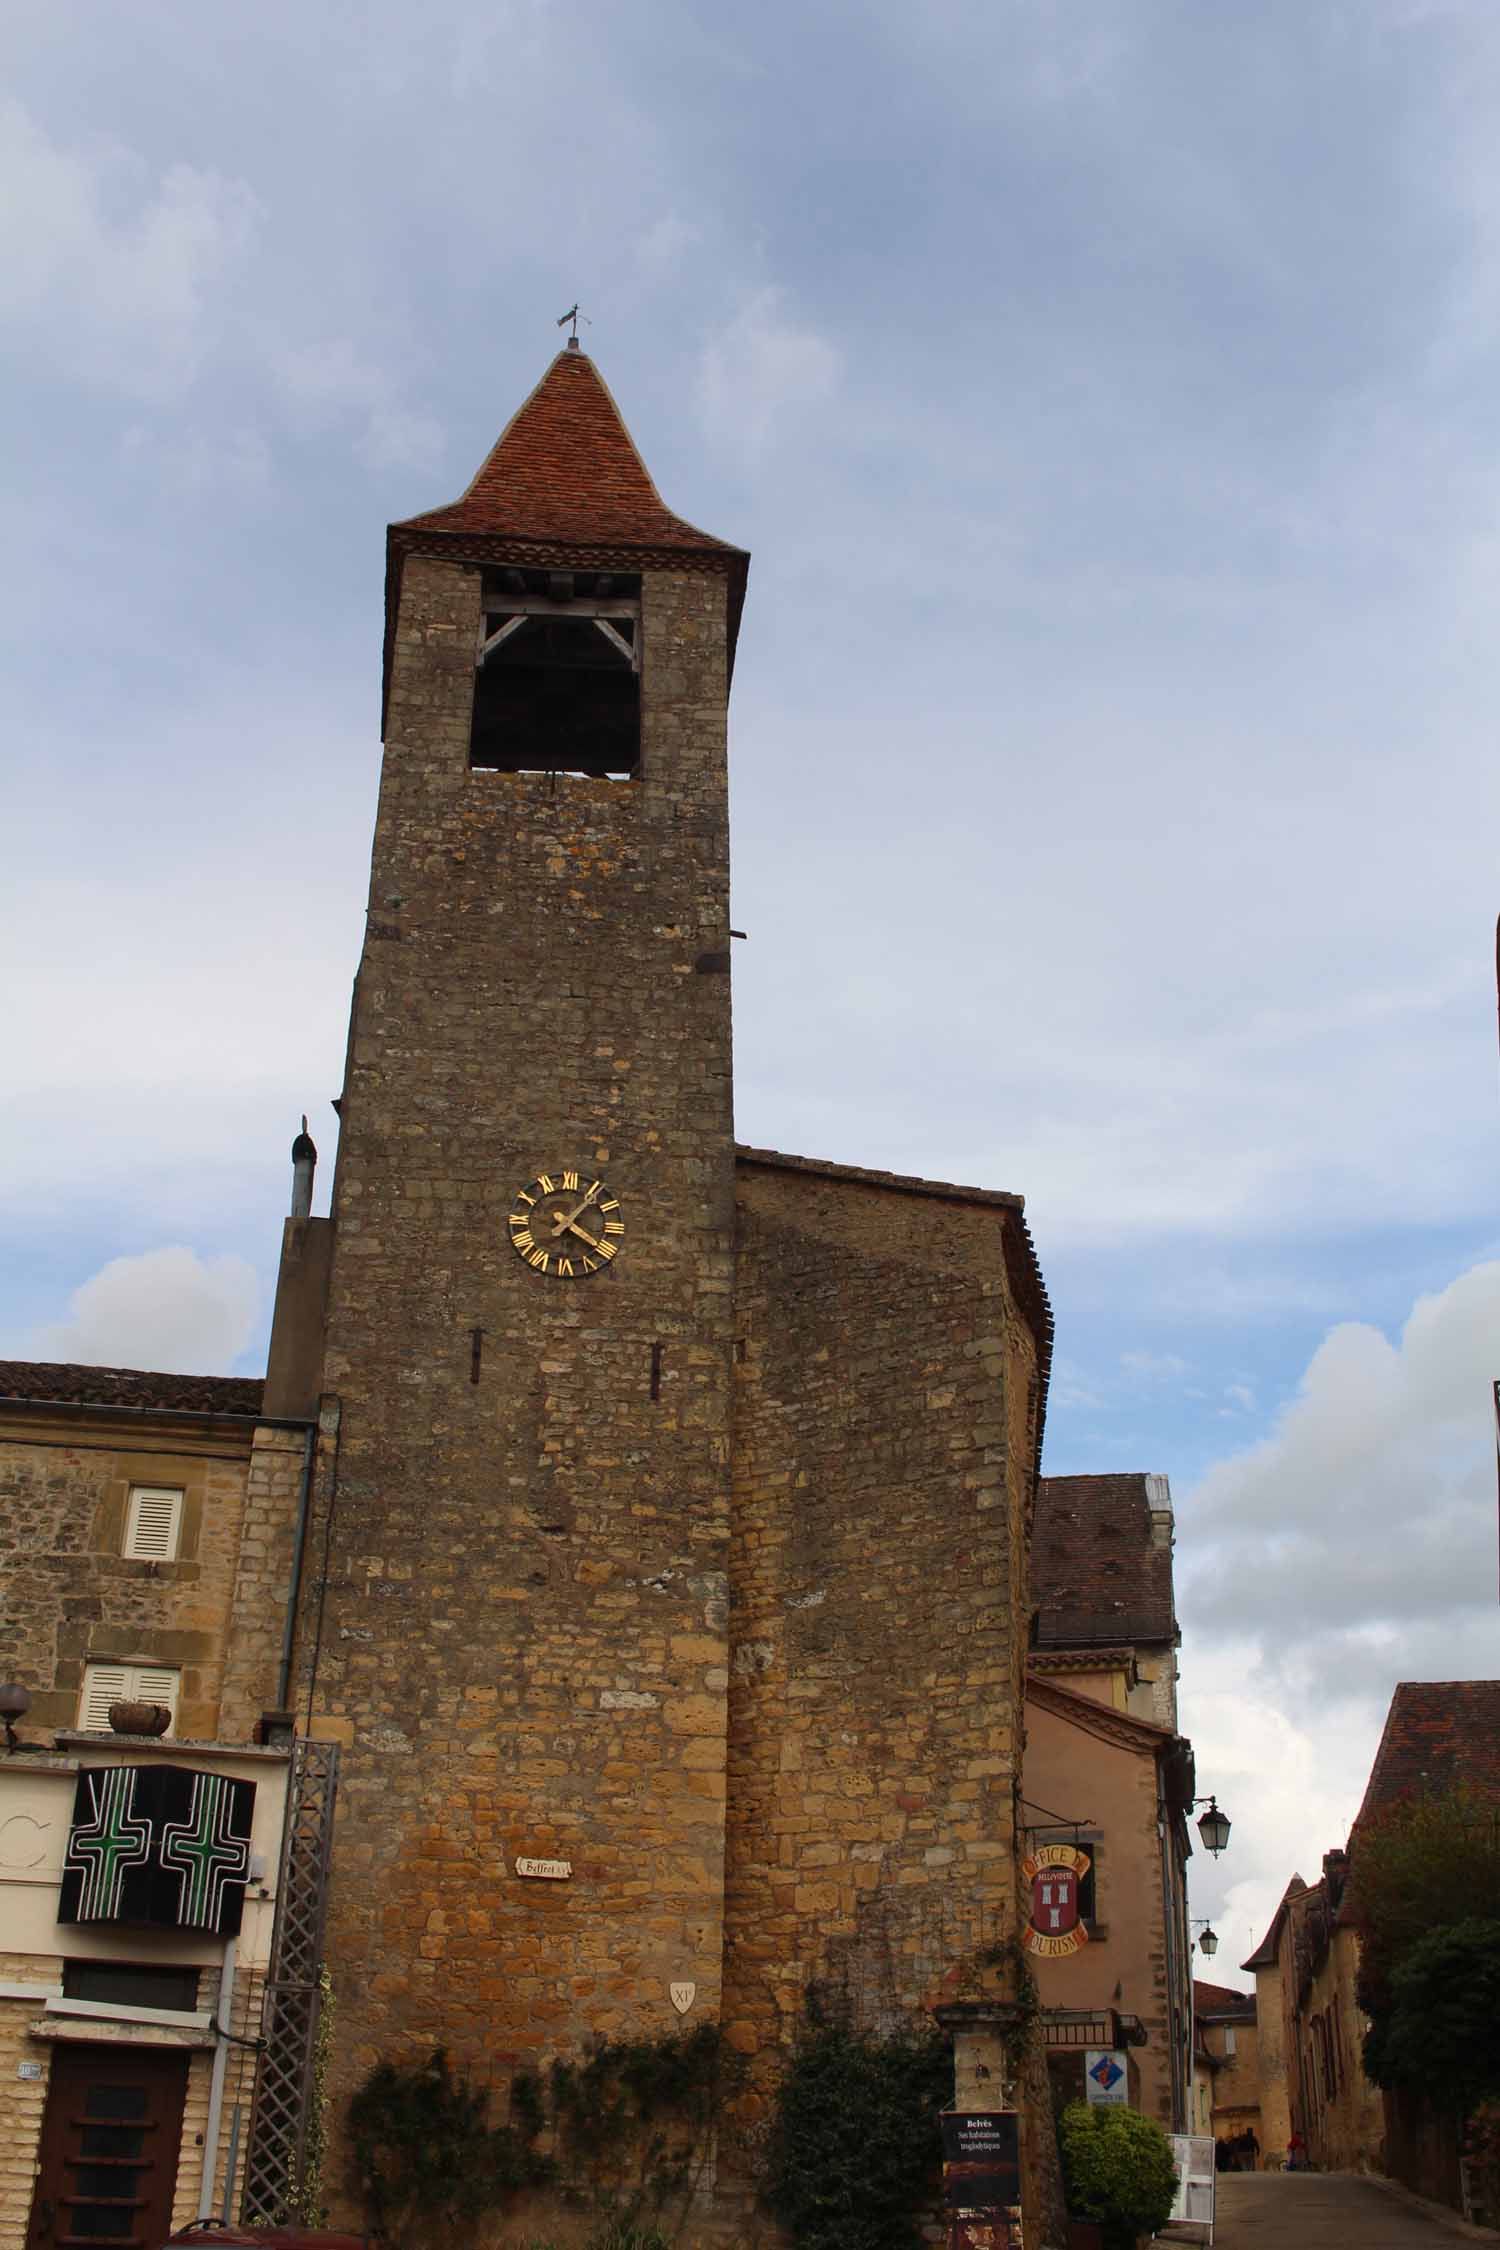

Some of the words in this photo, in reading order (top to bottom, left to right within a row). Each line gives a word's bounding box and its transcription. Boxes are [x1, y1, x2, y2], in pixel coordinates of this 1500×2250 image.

[537, 1175, 554, 1194] XI
[562, 1171, 578, 1190] XII
[517, 1191, 537, 1206] X
[600, 1199, 620, 1212] II
[604, 1222, 625, 1235] III
[511, 1230, 535, 1257] VIII
[528, 1249, 549, 1272] VII
[558, 1258, 574, 1276] VI
[583, 1255, 597, 1273] V
[1023, 1847, 1068, 1872] OFFICE
[1024, 1925, 1089, 1954] TOURISME
